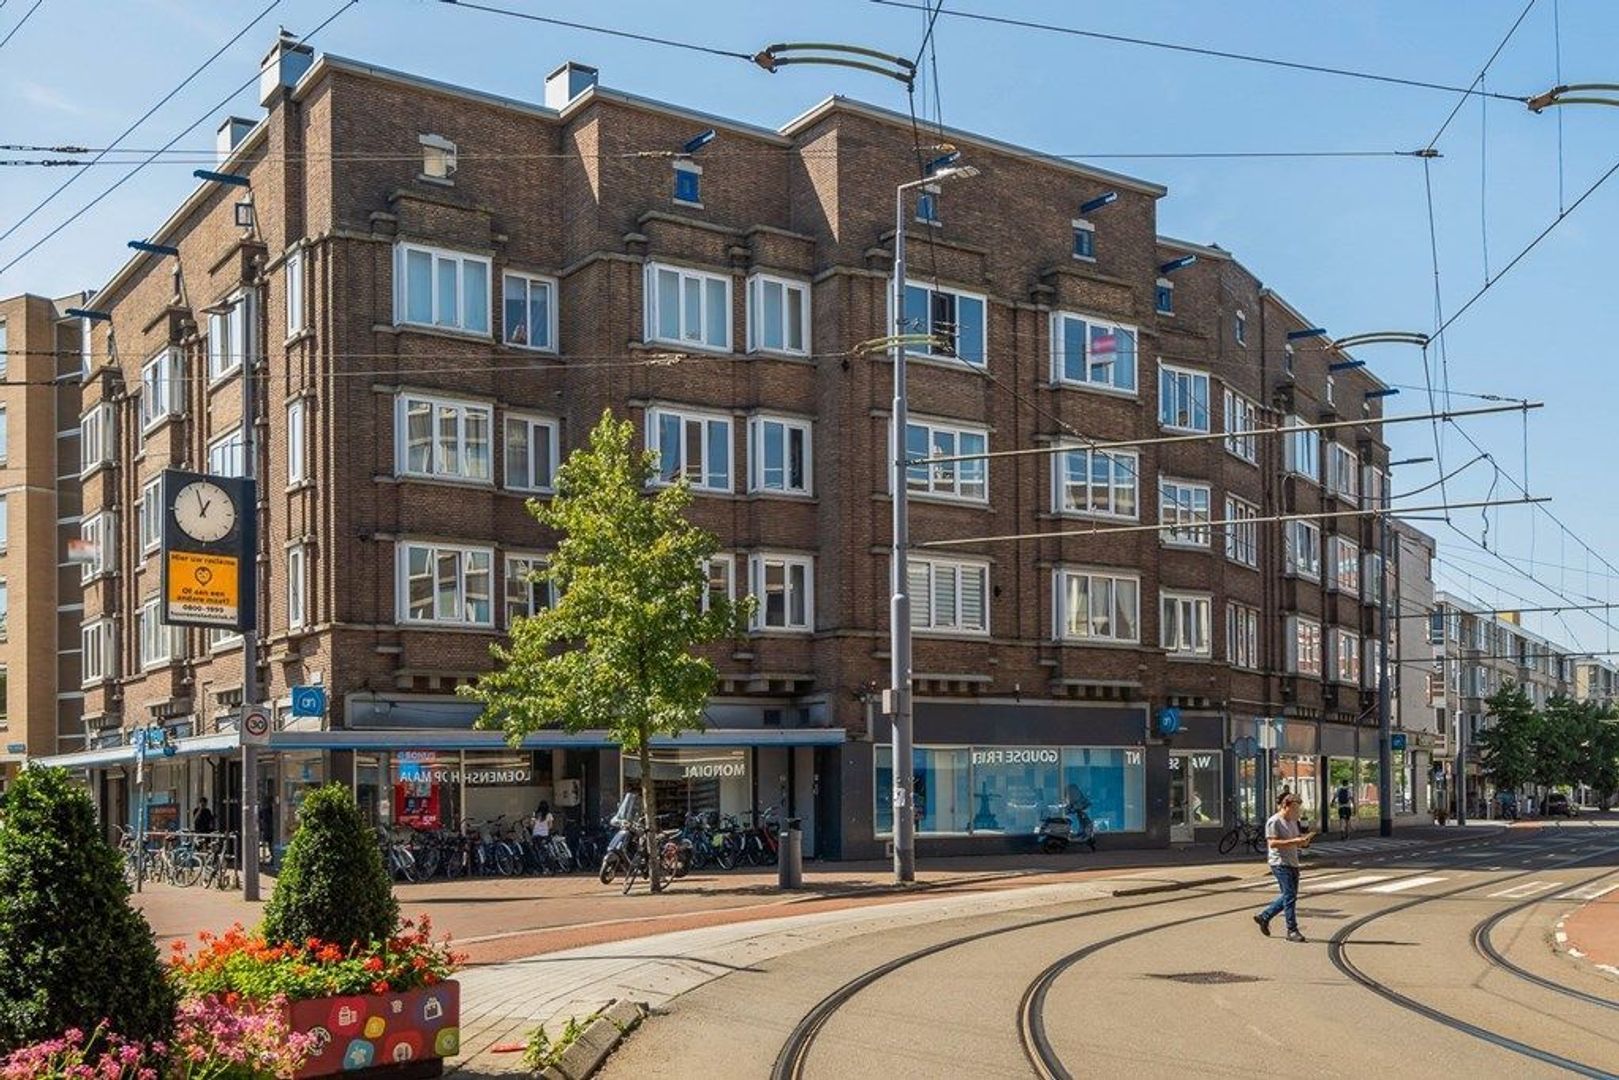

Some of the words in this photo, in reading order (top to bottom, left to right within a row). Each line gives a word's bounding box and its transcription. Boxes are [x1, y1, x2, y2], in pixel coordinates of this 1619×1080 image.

[171, 553, 189, 561] Hier
[204, 557, 235, 565] reclame
[177, 595, 205, 603] andere
[250, 719, 264, 729] 30
